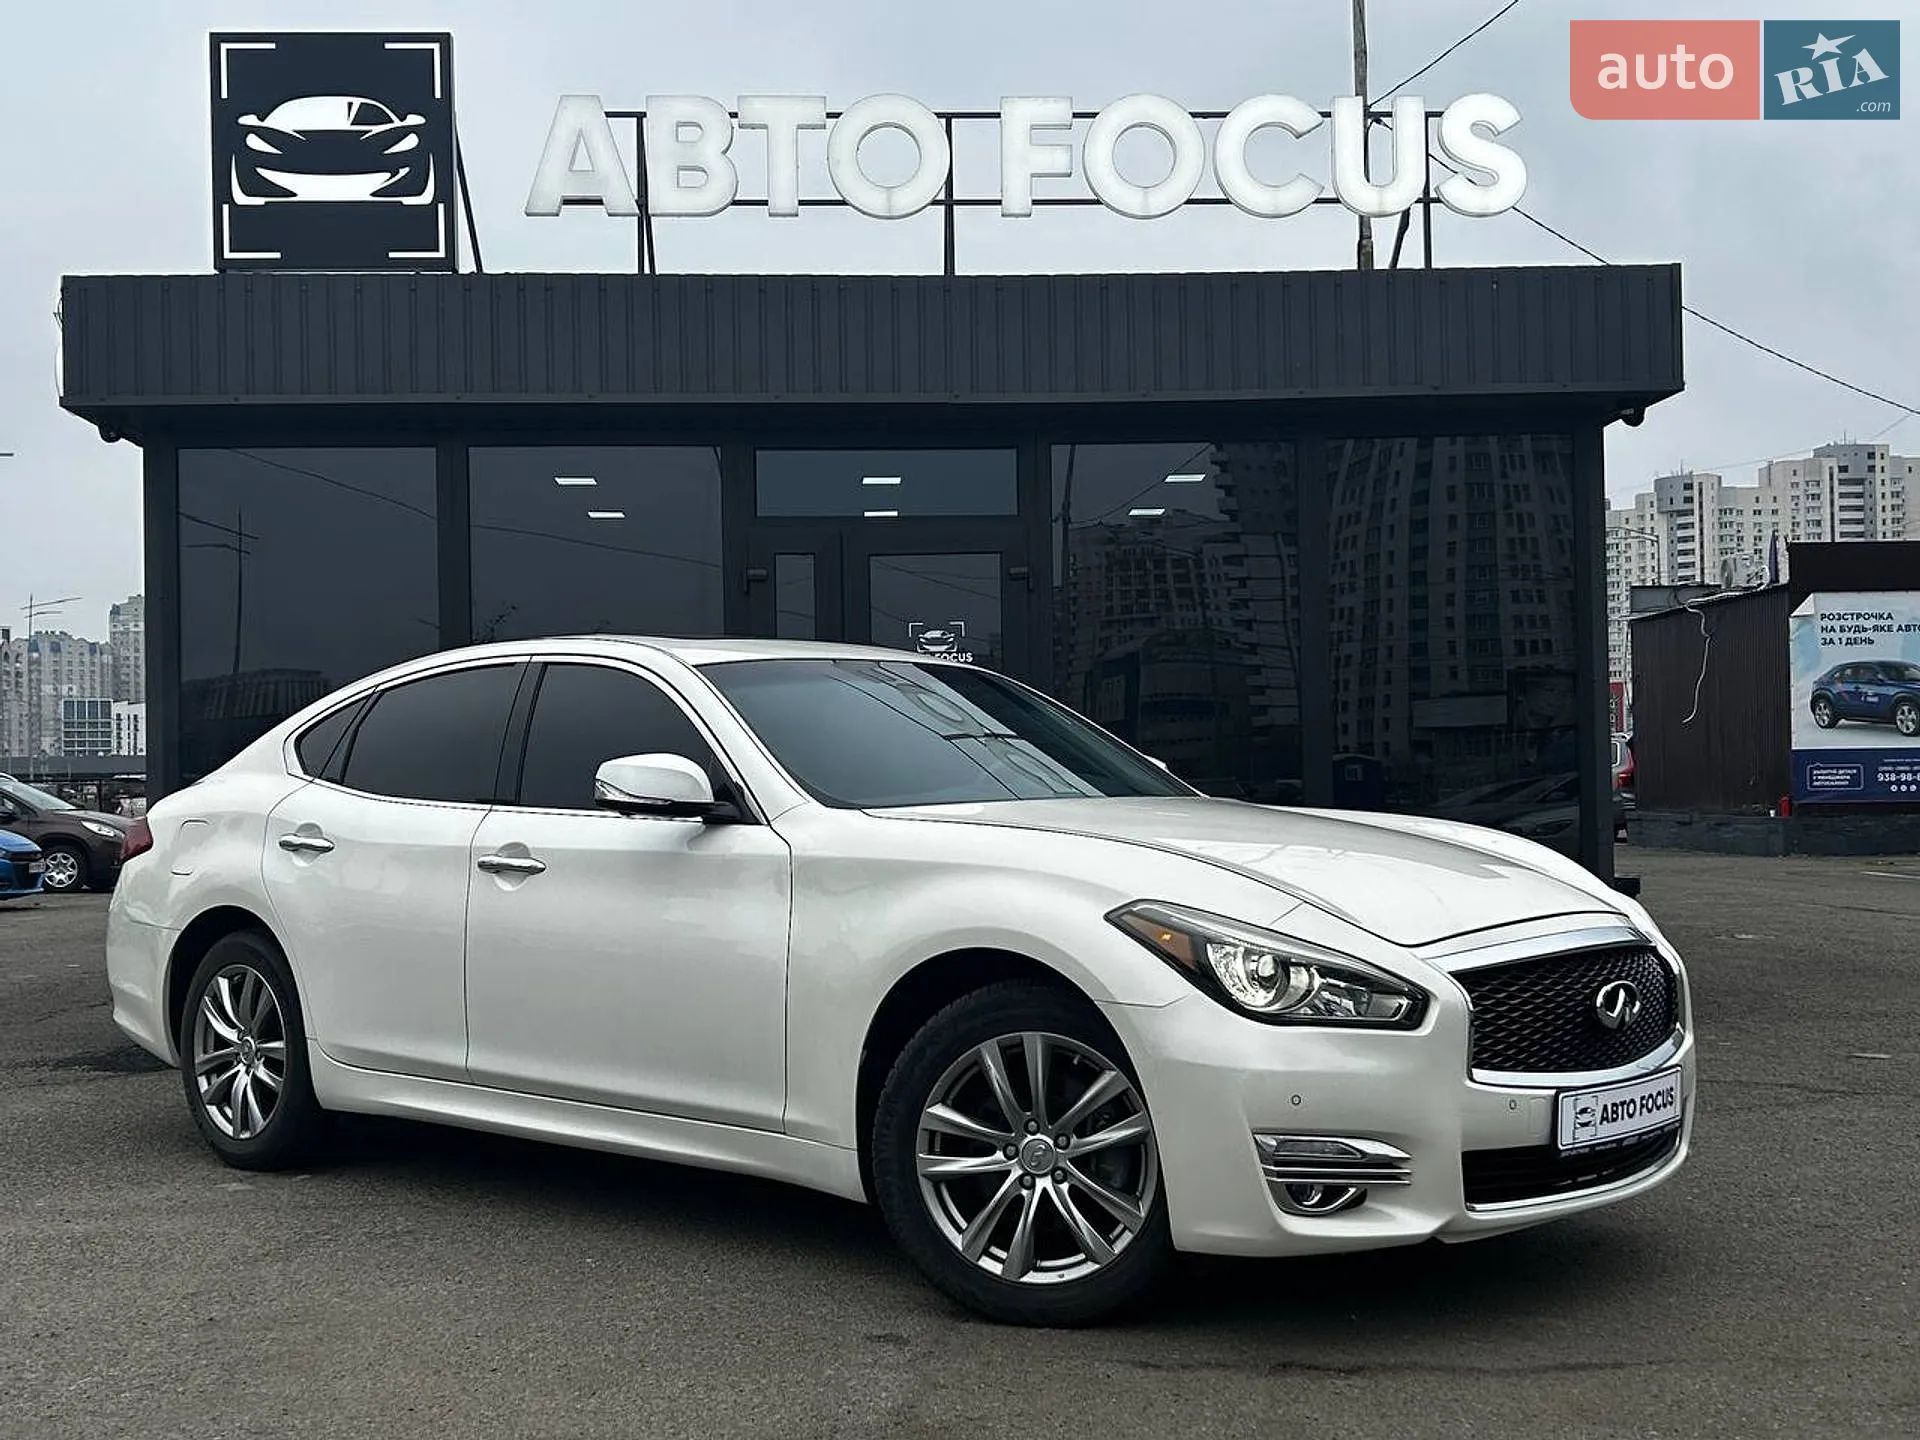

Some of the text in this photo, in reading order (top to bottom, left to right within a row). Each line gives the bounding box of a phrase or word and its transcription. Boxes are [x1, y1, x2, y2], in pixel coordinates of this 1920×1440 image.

[525, 93, 1528, 219] АВТО FOCUS
[1820, 612, 1894, 621] РОЗСТРОЧКА
[1820, 625, 1836, 633] НА
[1839, 624, 1894, 635] БУДЬ-ЯКЕ
[1820, 637, 1836, 646] ЗА
[1845, 636, 1875, 646] ДЕНЬ
[1599, 1086, 1674, 1126] АВТО FOCUS
